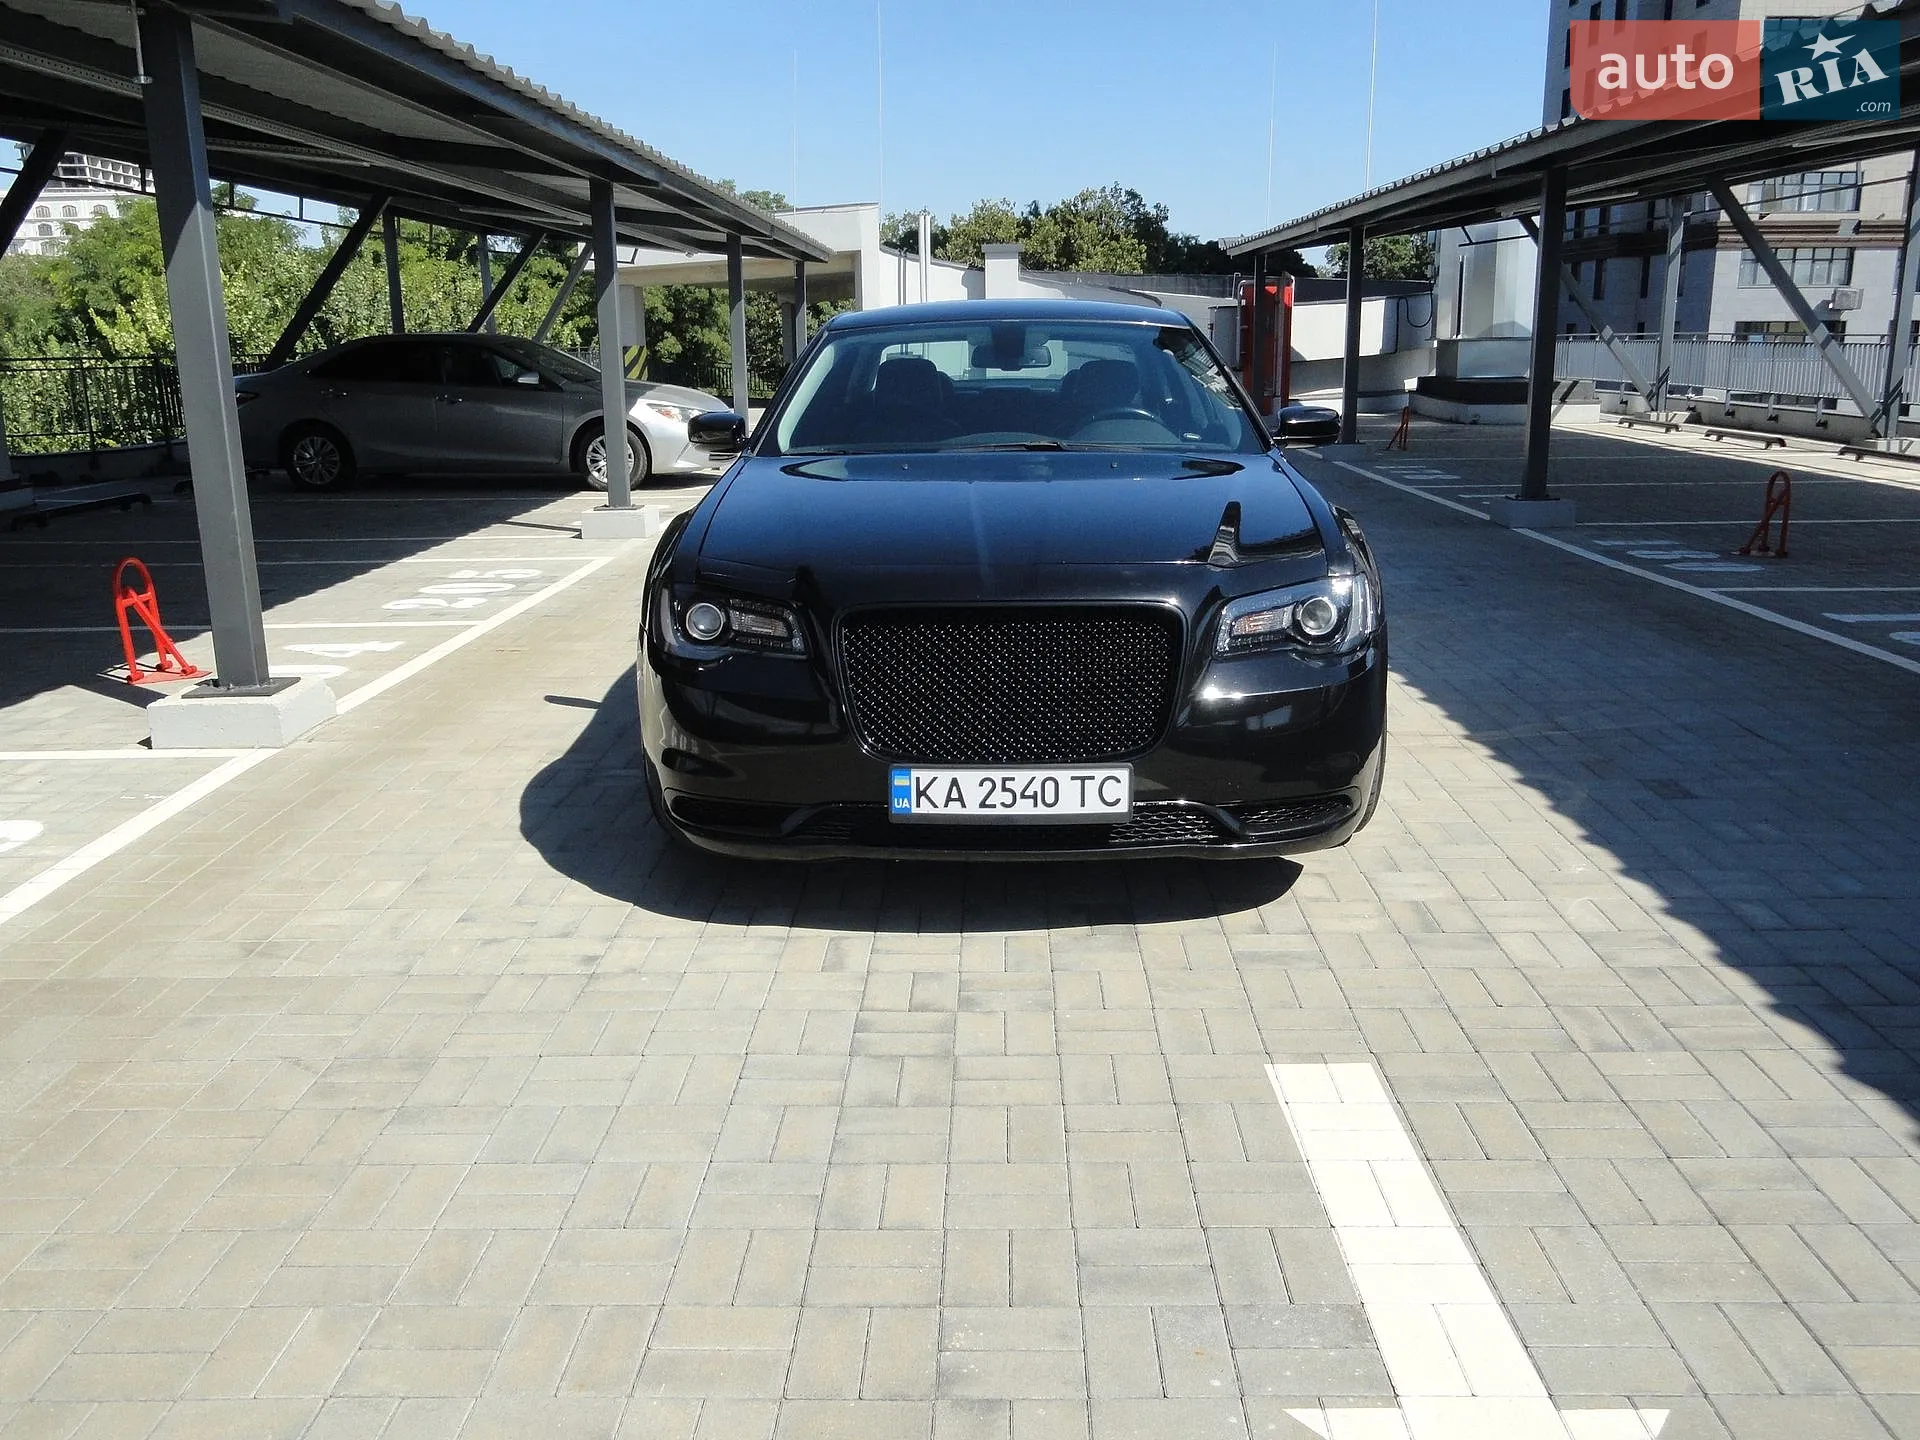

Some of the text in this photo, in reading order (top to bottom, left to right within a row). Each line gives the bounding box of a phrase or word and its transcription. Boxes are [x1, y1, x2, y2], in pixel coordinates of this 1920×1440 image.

[381, 568, 543, 610] 205
[269, 640, 406, 680] 04
[894, 798, 910, 809] UA
[915, 775, 1122, 809] KA 2540 TC
